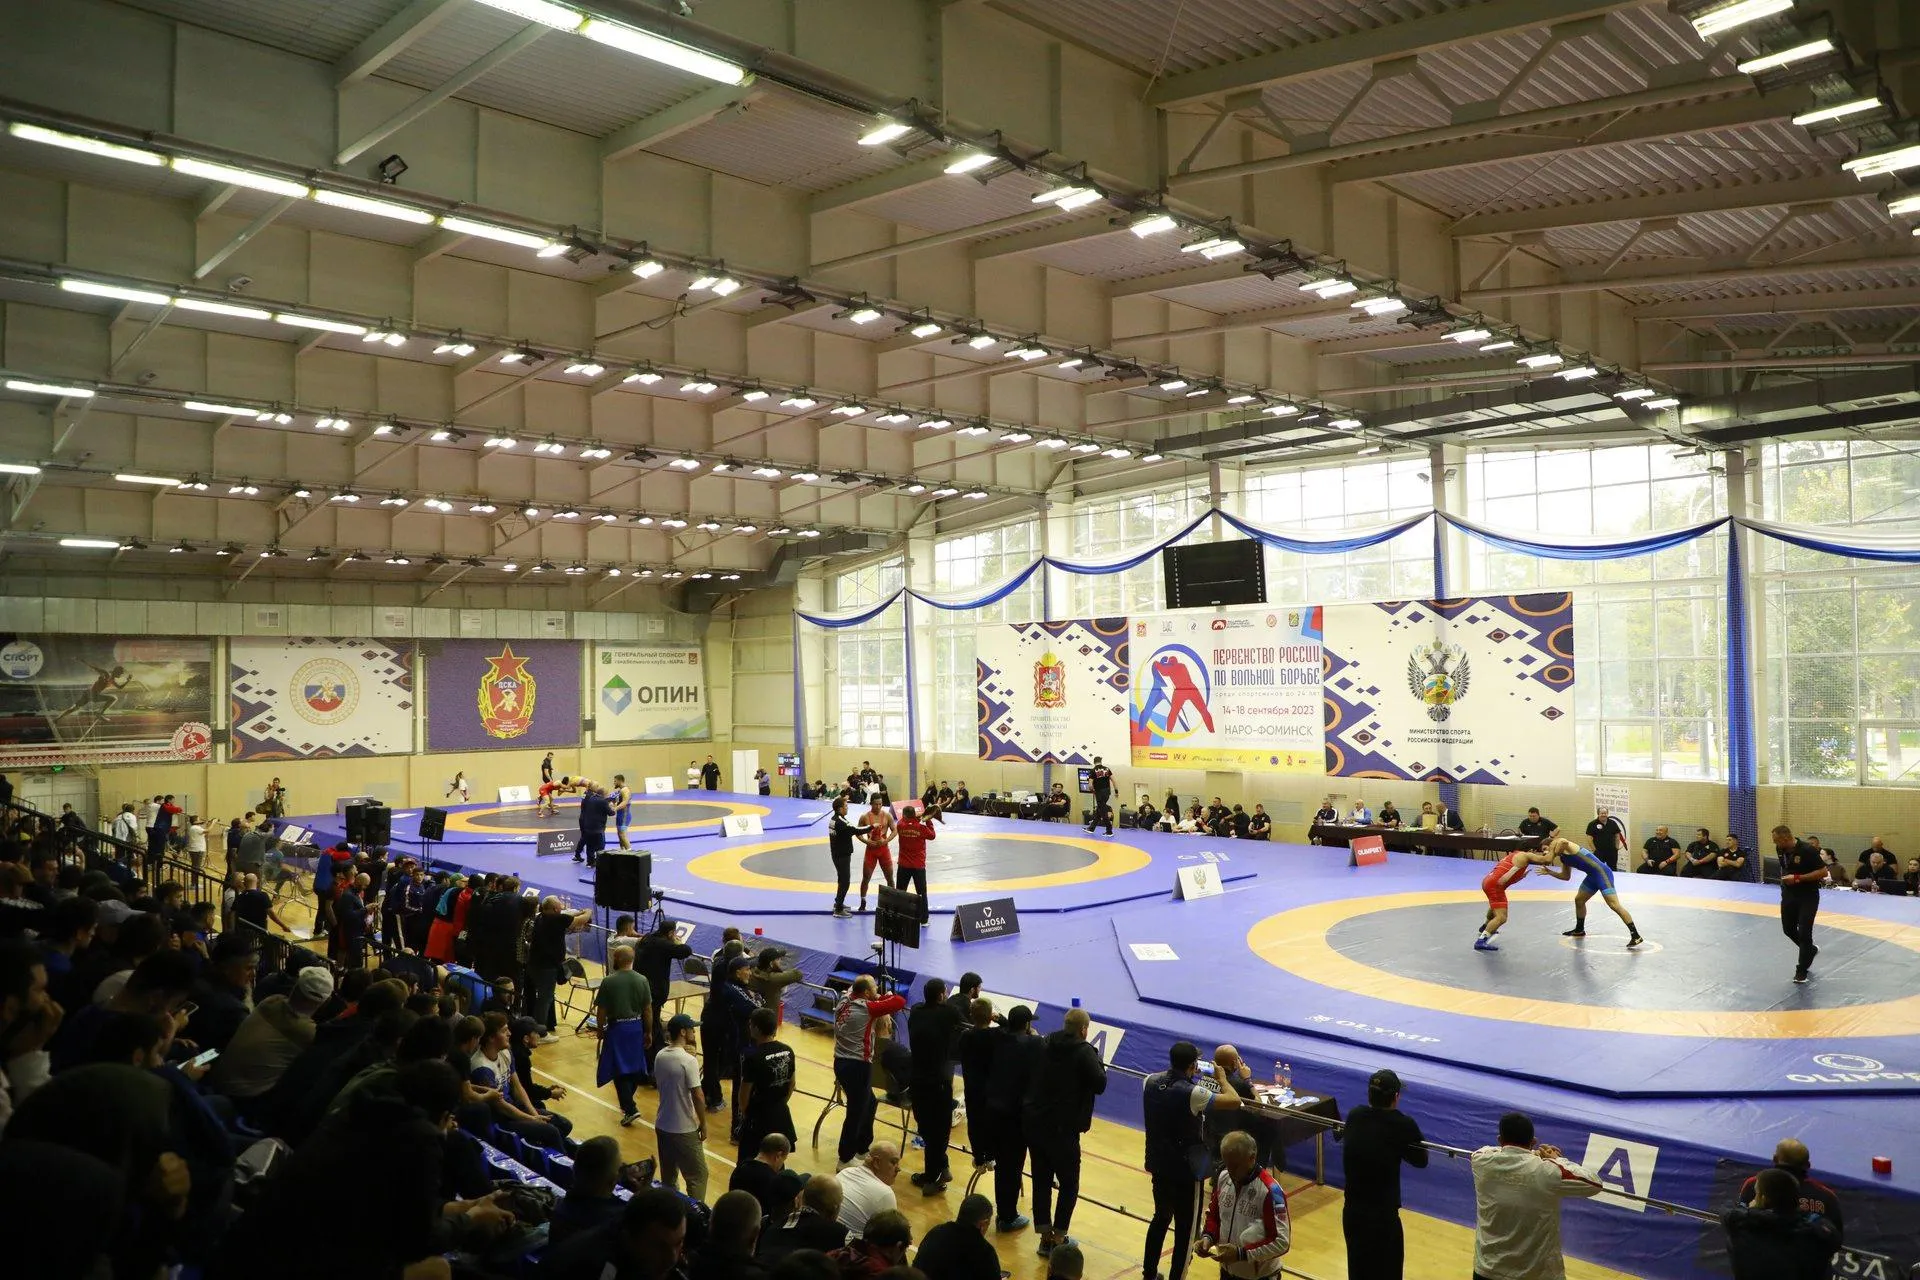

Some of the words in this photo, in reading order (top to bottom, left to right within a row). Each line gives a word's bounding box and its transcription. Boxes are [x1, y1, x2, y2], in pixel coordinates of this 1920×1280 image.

[3, 654, 39, 662] СПОРТ
[1213, 647, 1274, 665] ПЕРВЕНСТВО
[1279, 645, 1320, 663] РОССИИ
[1214, 669, 1227, 686] ПО
[1231, 666, 1275, 686] ВОЛЬНОЙ
[1280, 667, 1320, 685] БОРЬБЕ
[498, 681, 517, 689] ЦСКА
[637, 685, 698, 704] ОПИН
[1222, 705, 1245, 715] 14-18
[1247, 705, 1289, 717] сентября
[1291, 705, 1314, 715] 2023
[1224, 724, 1313, 736] НАРО-ФОМИНСК
[1441, 737, 1474, 745] ФЕДЕРАЦИИ
[550, 841, 575, 849] ALROSA
[975, 916, 1006, 929] ALROSA
[1597, 1147, 1636, 1195] A
